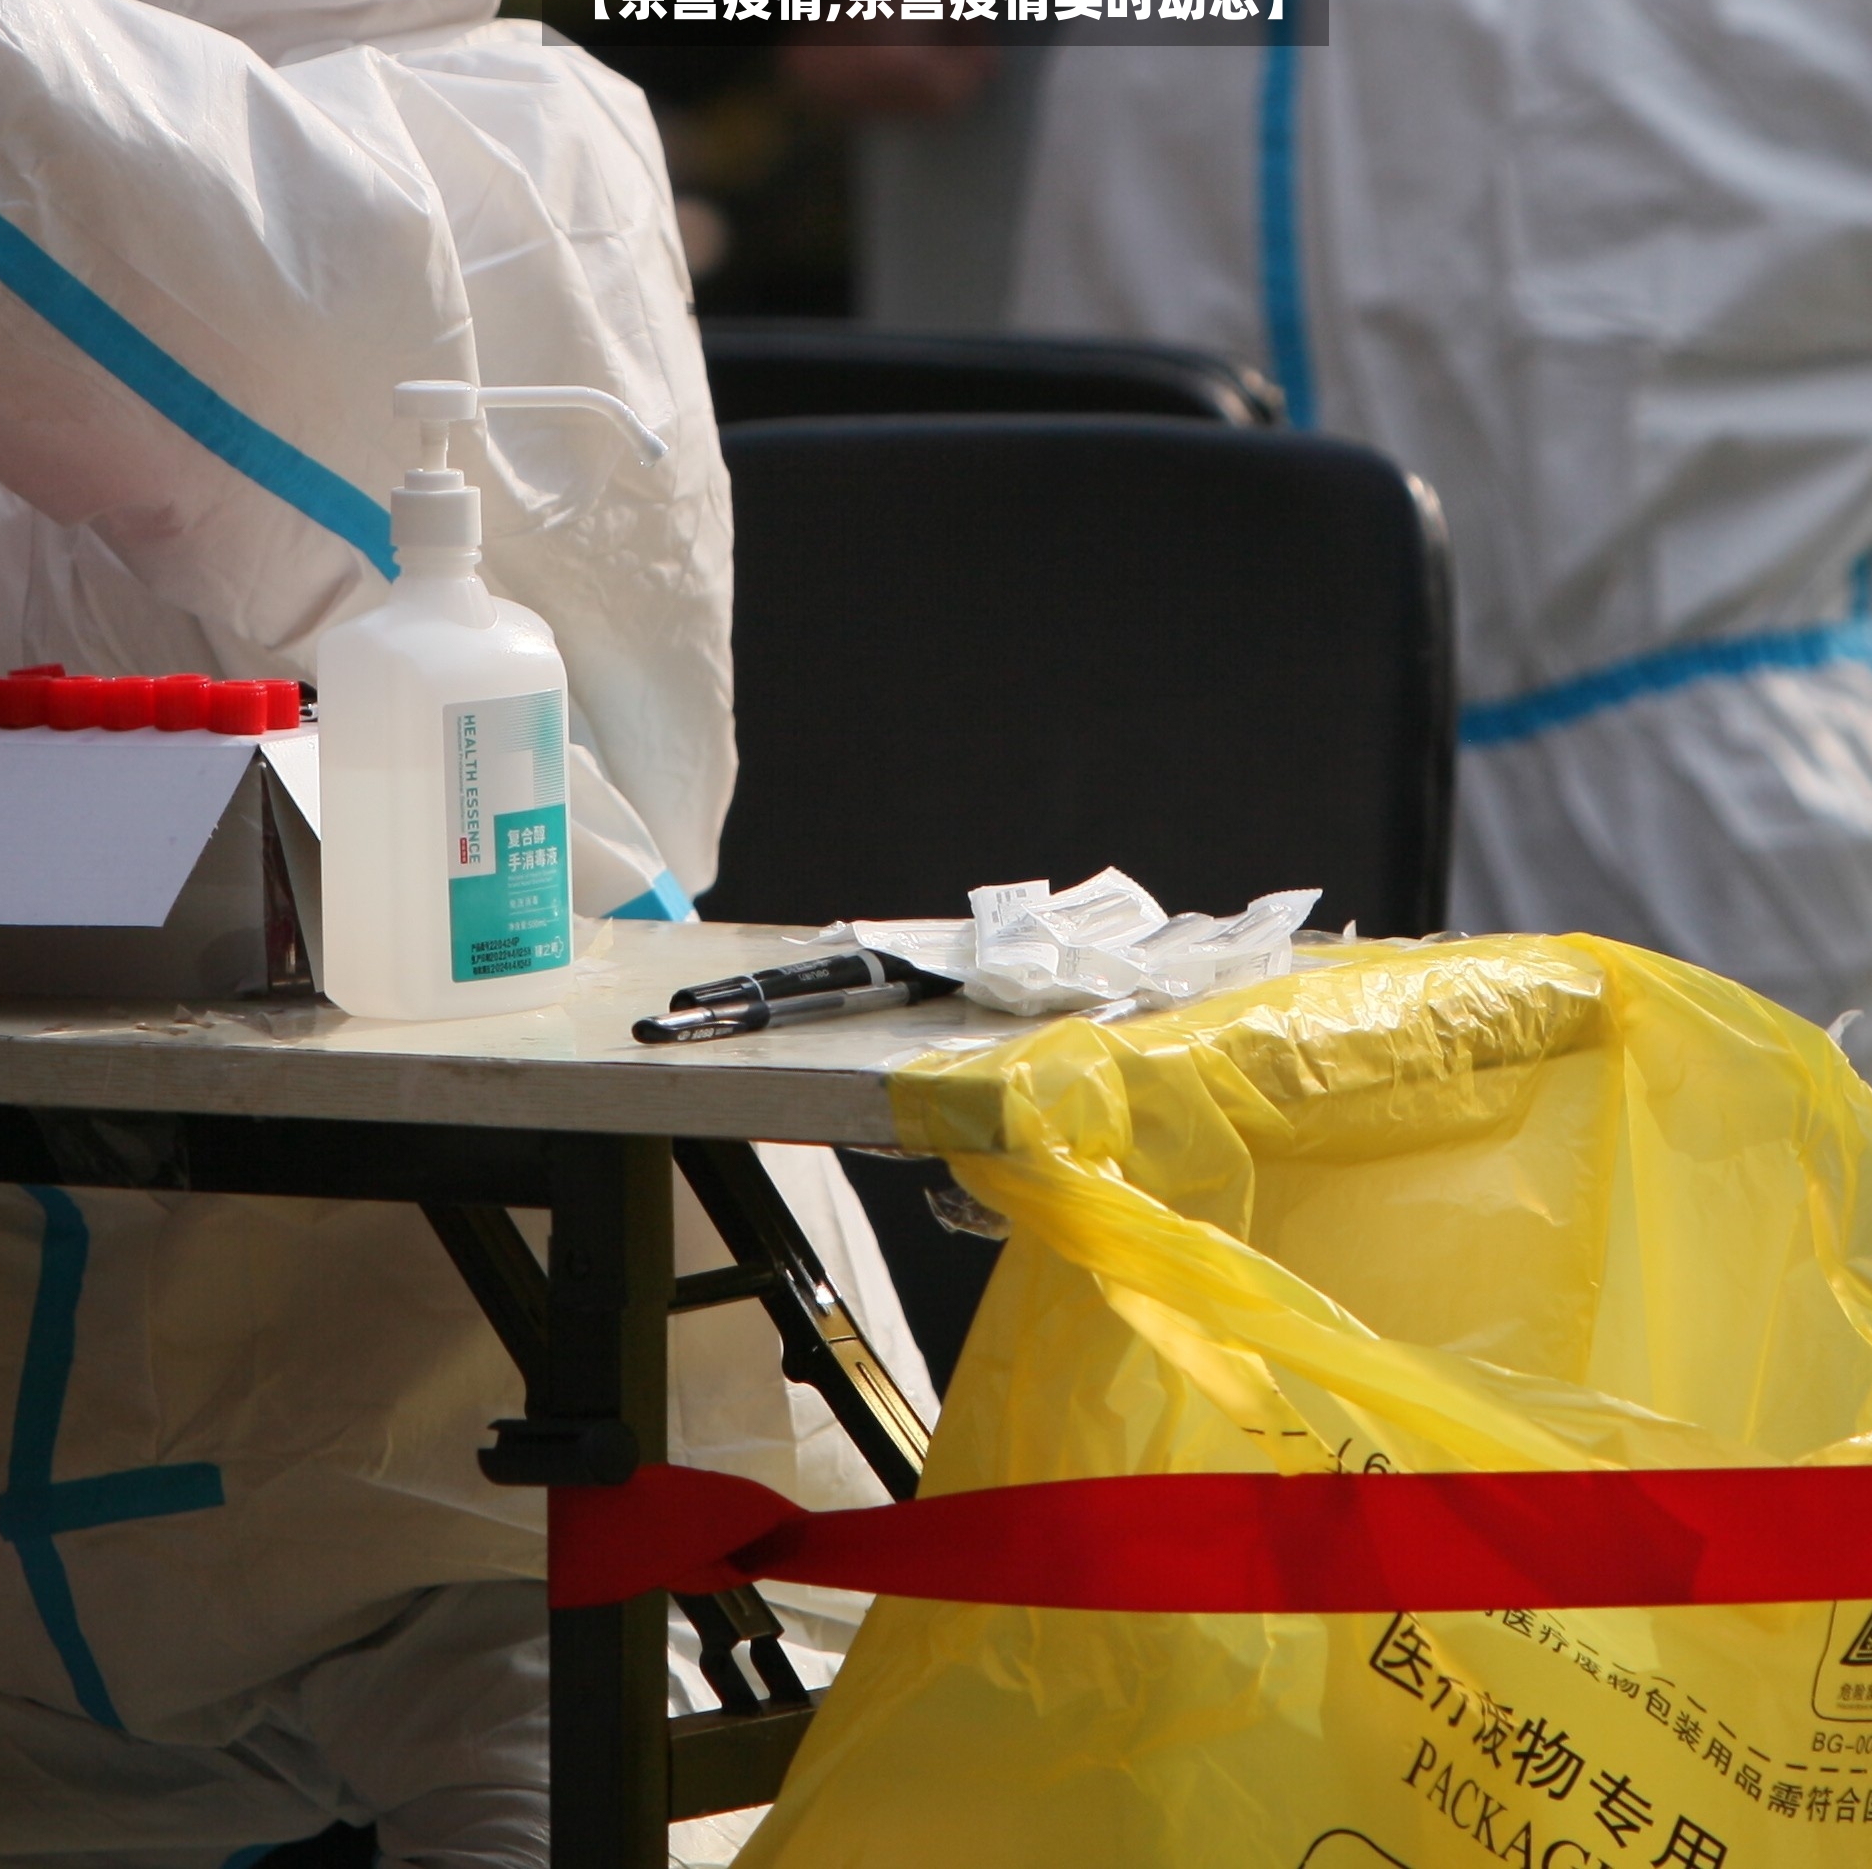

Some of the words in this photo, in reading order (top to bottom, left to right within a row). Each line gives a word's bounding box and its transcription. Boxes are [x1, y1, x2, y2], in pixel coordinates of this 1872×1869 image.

[464, 714, 477, 782] HEALTH
[466, 787, 480, 864] ESSENCE
[508, 825, 545, 849] 复合醇
[509, 846, 558, 872] 手消毒液
[1402, 1737, 1612, 1869] PACKAG
